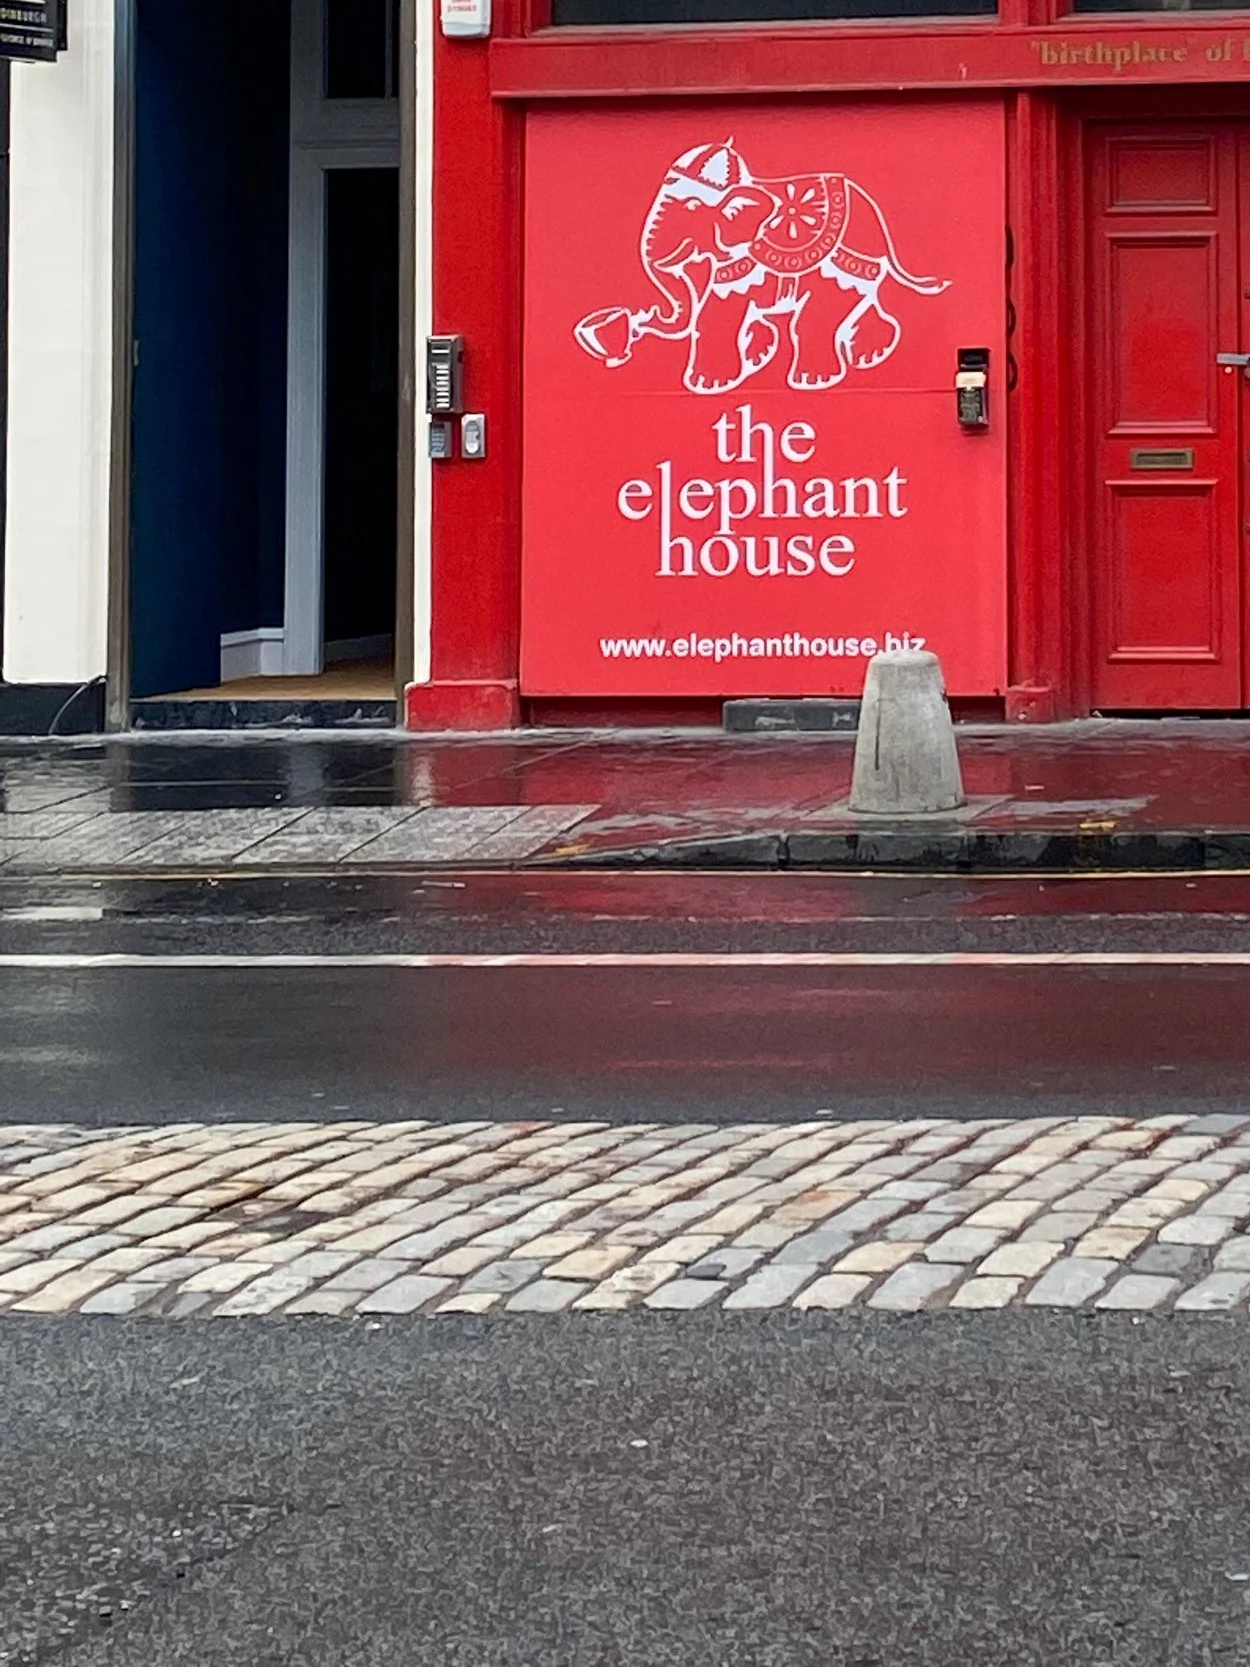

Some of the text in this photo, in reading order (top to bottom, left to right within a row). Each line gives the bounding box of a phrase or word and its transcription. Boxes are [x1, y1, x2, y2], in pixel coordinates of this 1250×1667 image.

[1205, 38, 1236, 62] of
[711, 404, 817, 463] the
[616, 460, 909, 535] elephant
[655, 533, 856, 577] house
